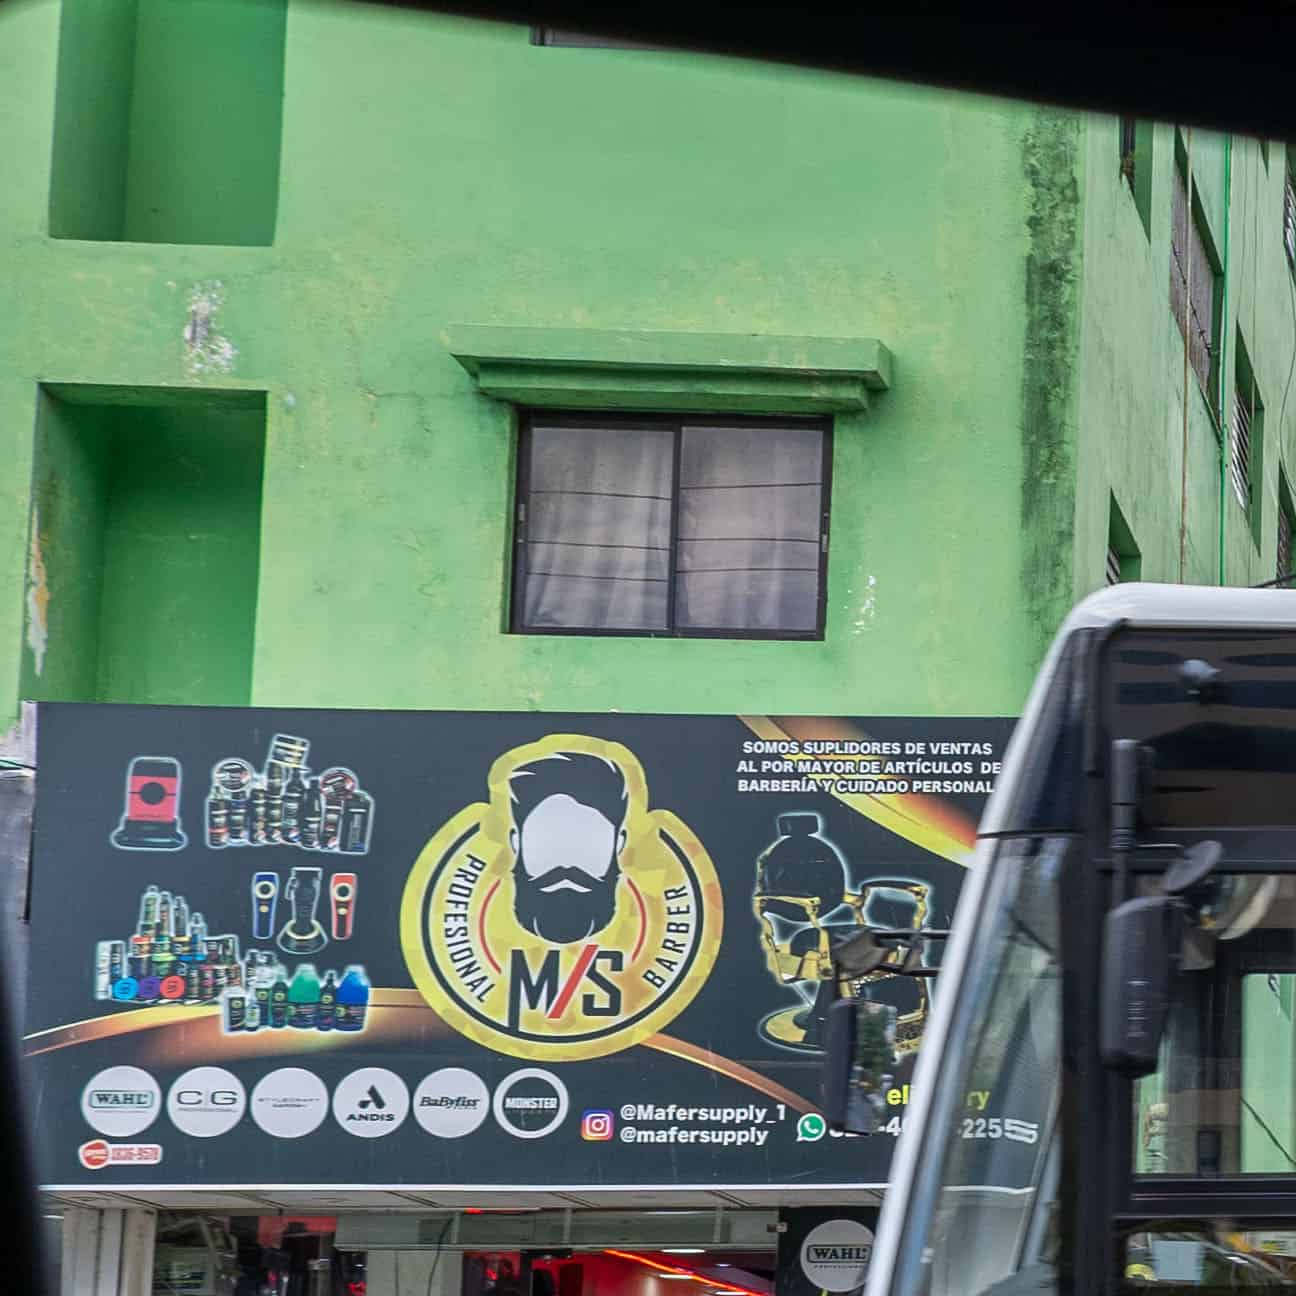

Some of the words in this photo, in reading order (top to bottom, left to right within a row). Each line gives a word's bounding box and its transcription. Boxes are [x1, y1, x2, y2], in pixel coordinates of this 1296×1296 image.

[743, 741, 800, 754] SOMOS
[803, 741, 901, 755] SUPLIDORES
[905, 742, 925, 755] DE
[929, 742, 992, 755] VENTAS
[737, 760, 758, 773] AL
[762, 760, 794, 773] POR
[798, 760, 857, 774] MAYOR
[860, 761, 880, 774] DE
[884, 758, 973, 774] ARTÍCULOS
[981, 762, 1001, 774] DE
[738, 777, 817, 792] BARBERÍA
[821, 780, 833, 792] Y
[836, 780, 909, 793] CUIDADO
[912, 780, 996, 793] PERSONAL
[444, 853, 496, 1003] PROFESIONAL
[642, 884, 692, 989] BARBER
[95, 1092, 148, 1106] WAHL
[346, 1112, 395, 1122] ANDIS
[620, 1104, 786, 1124] @Mafersupply_1
[620, 1126, 769, 1146] @mafersupply
[813, 1247, 868, 1260] WAHL
